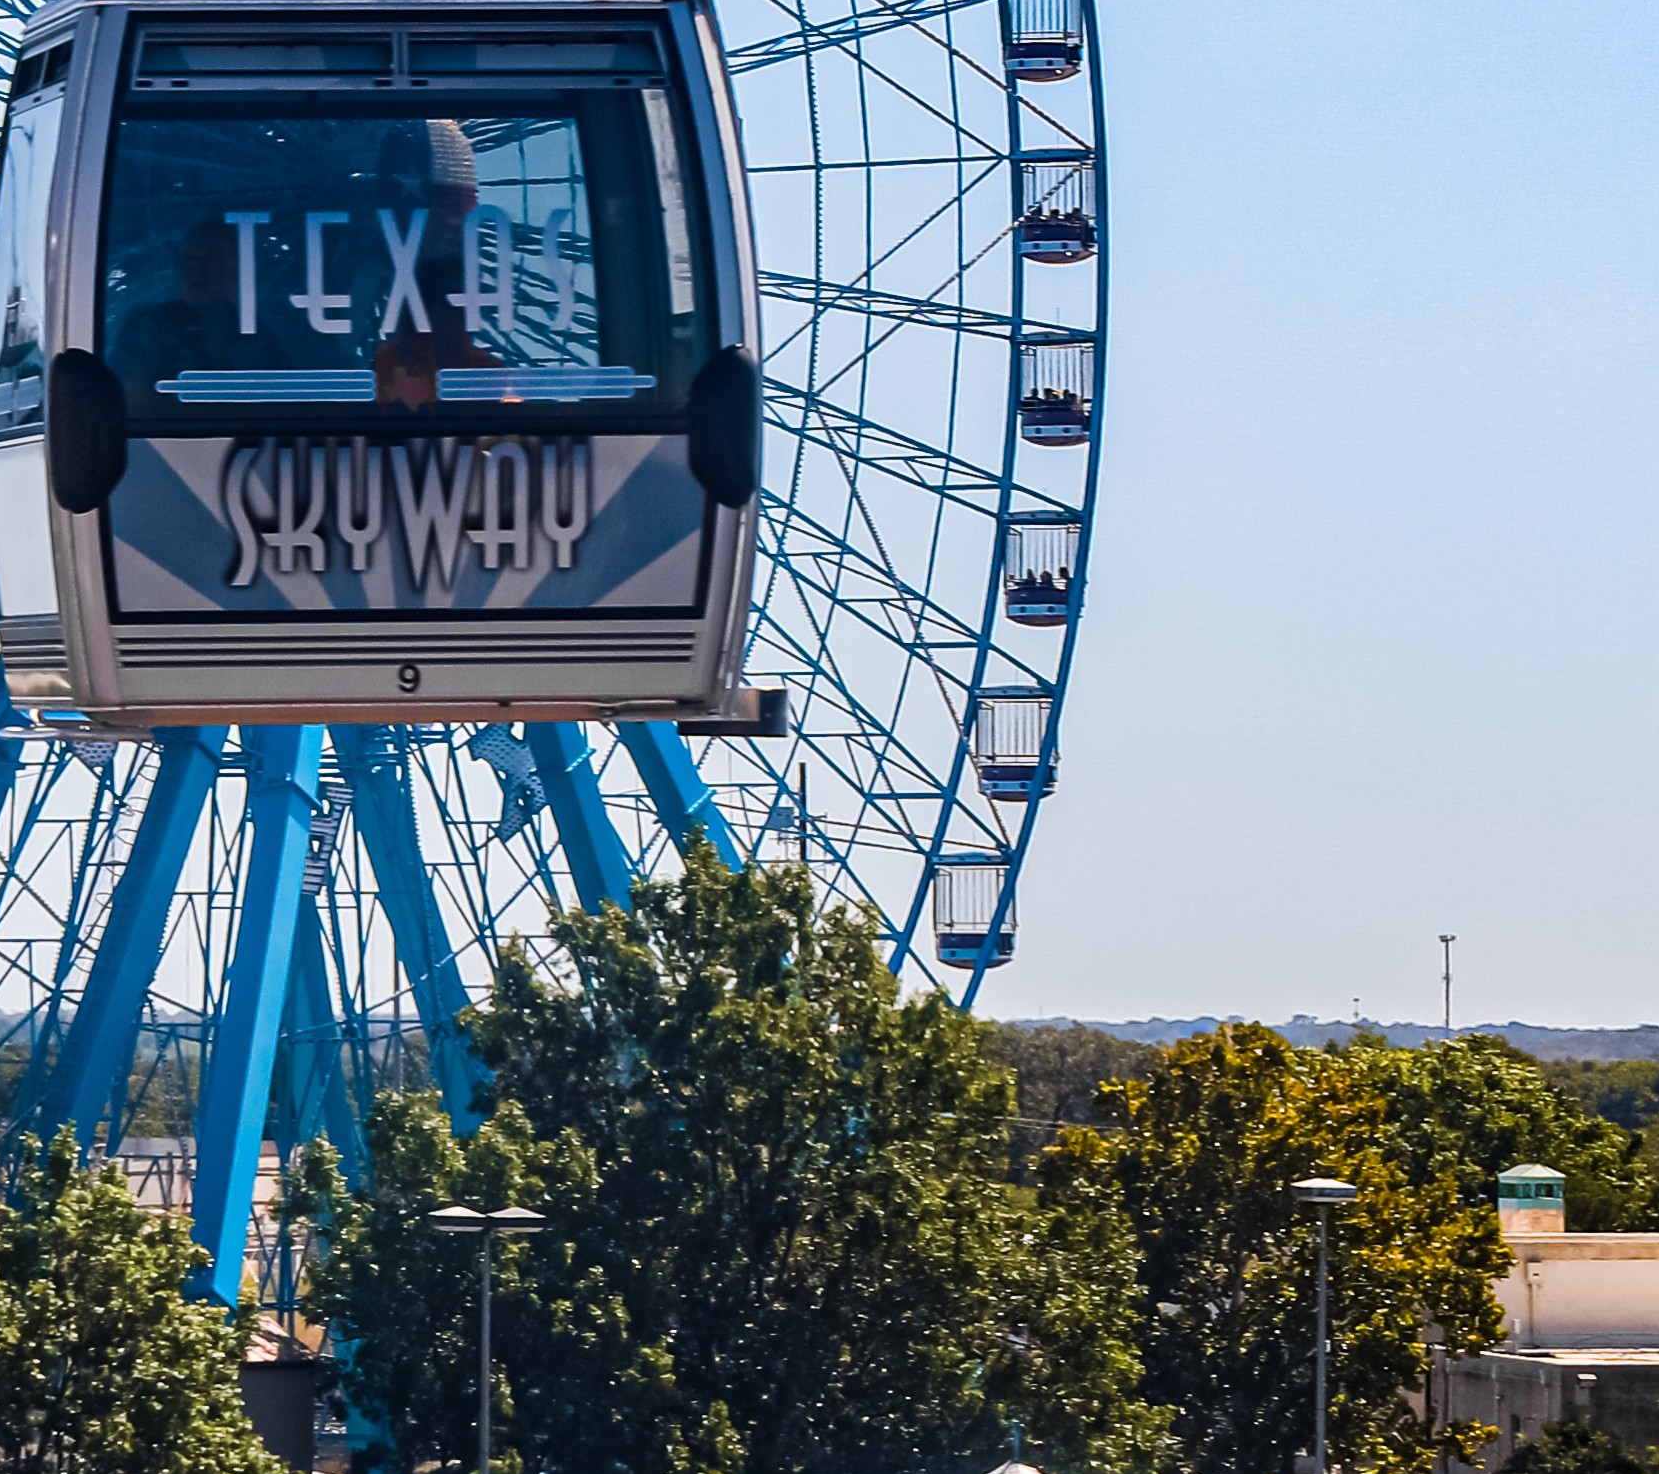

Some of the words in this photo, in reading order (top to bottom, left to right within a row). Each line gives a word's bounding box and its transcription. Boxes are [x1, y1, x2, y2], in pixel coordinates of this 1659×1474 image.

[224, 203, 576, 337] TEXAS
[226, 442, 592, 590] SKYWAY
[397, 664, 421, 694] 9
